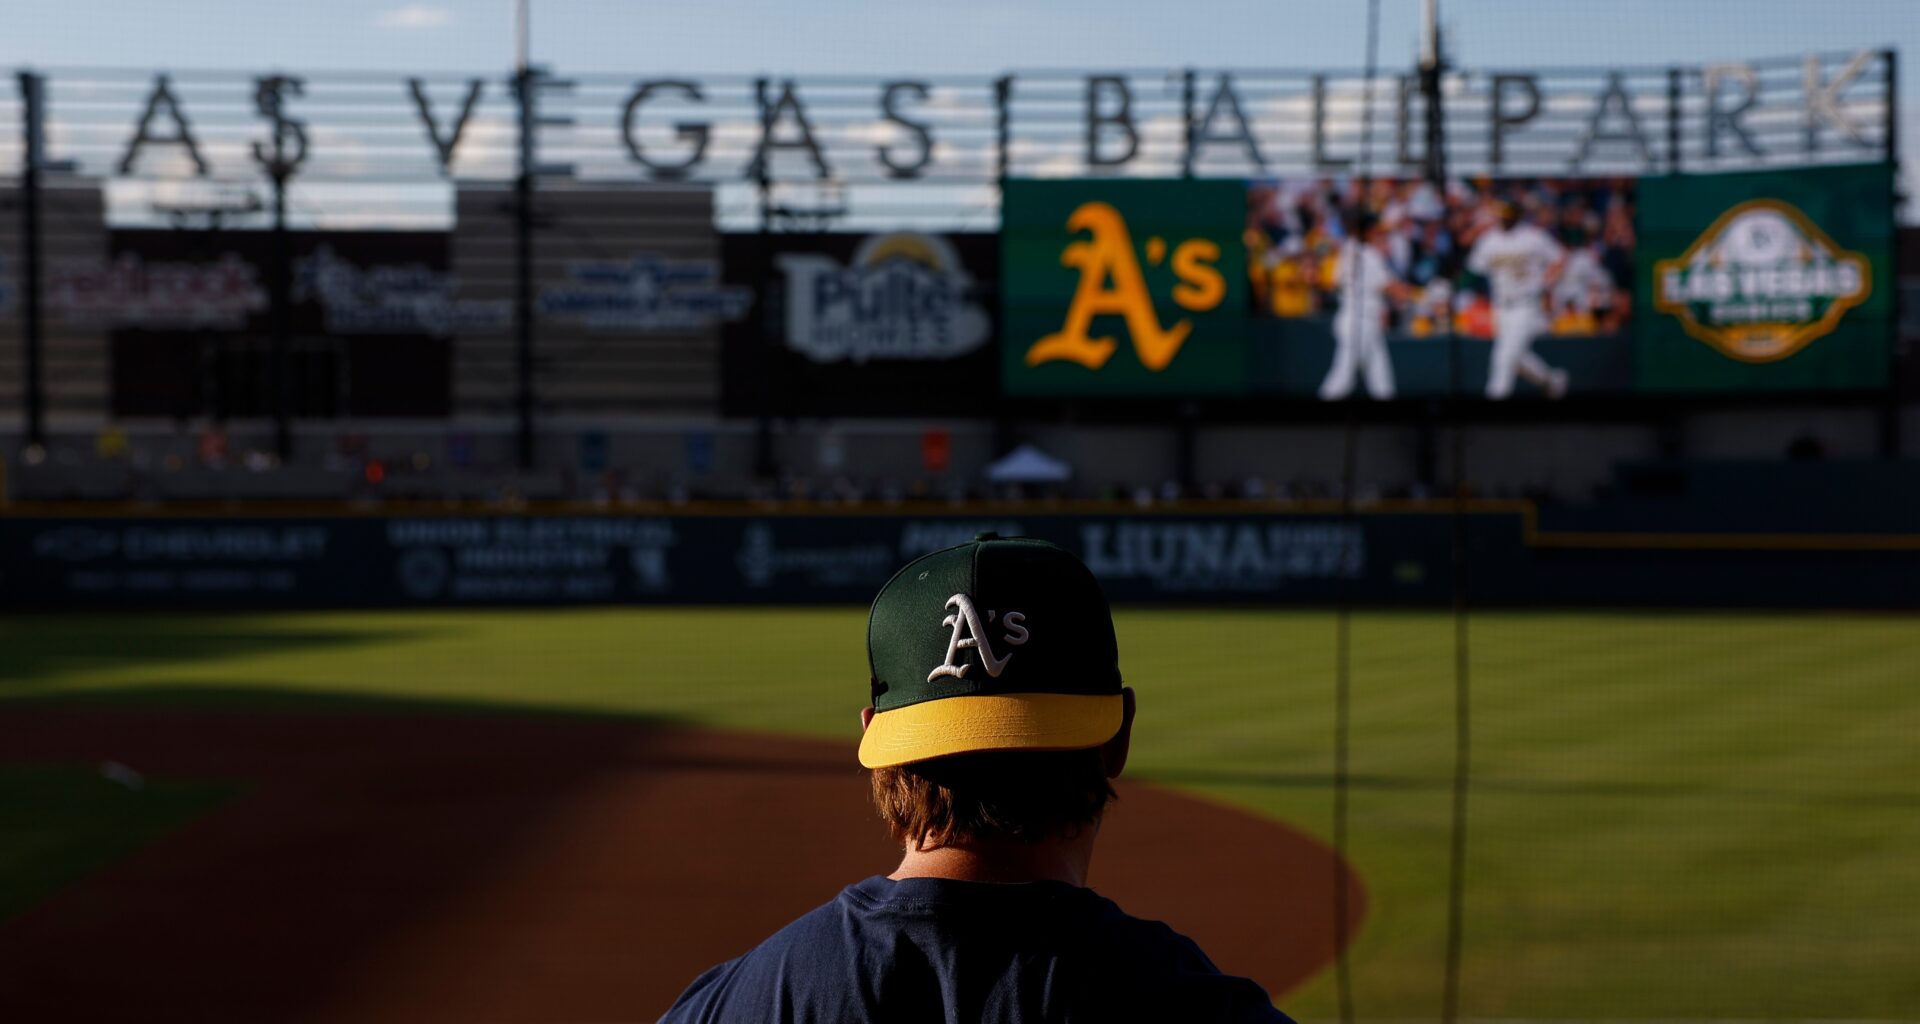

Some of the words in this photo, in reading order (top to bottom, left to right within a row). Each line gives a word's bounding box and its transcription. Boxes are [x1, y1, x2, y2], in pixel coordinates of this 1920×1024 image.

[22, 72, 309, 176] LAS
[407, 76, 933, 178] VEGAS
[1087, 50, 1884, 174] BALLPARK
[1025, 201, 1226, 371] A's
[1082, 522, 1265, 577] LIUNA
[927, 593, 1029, 683] A's
